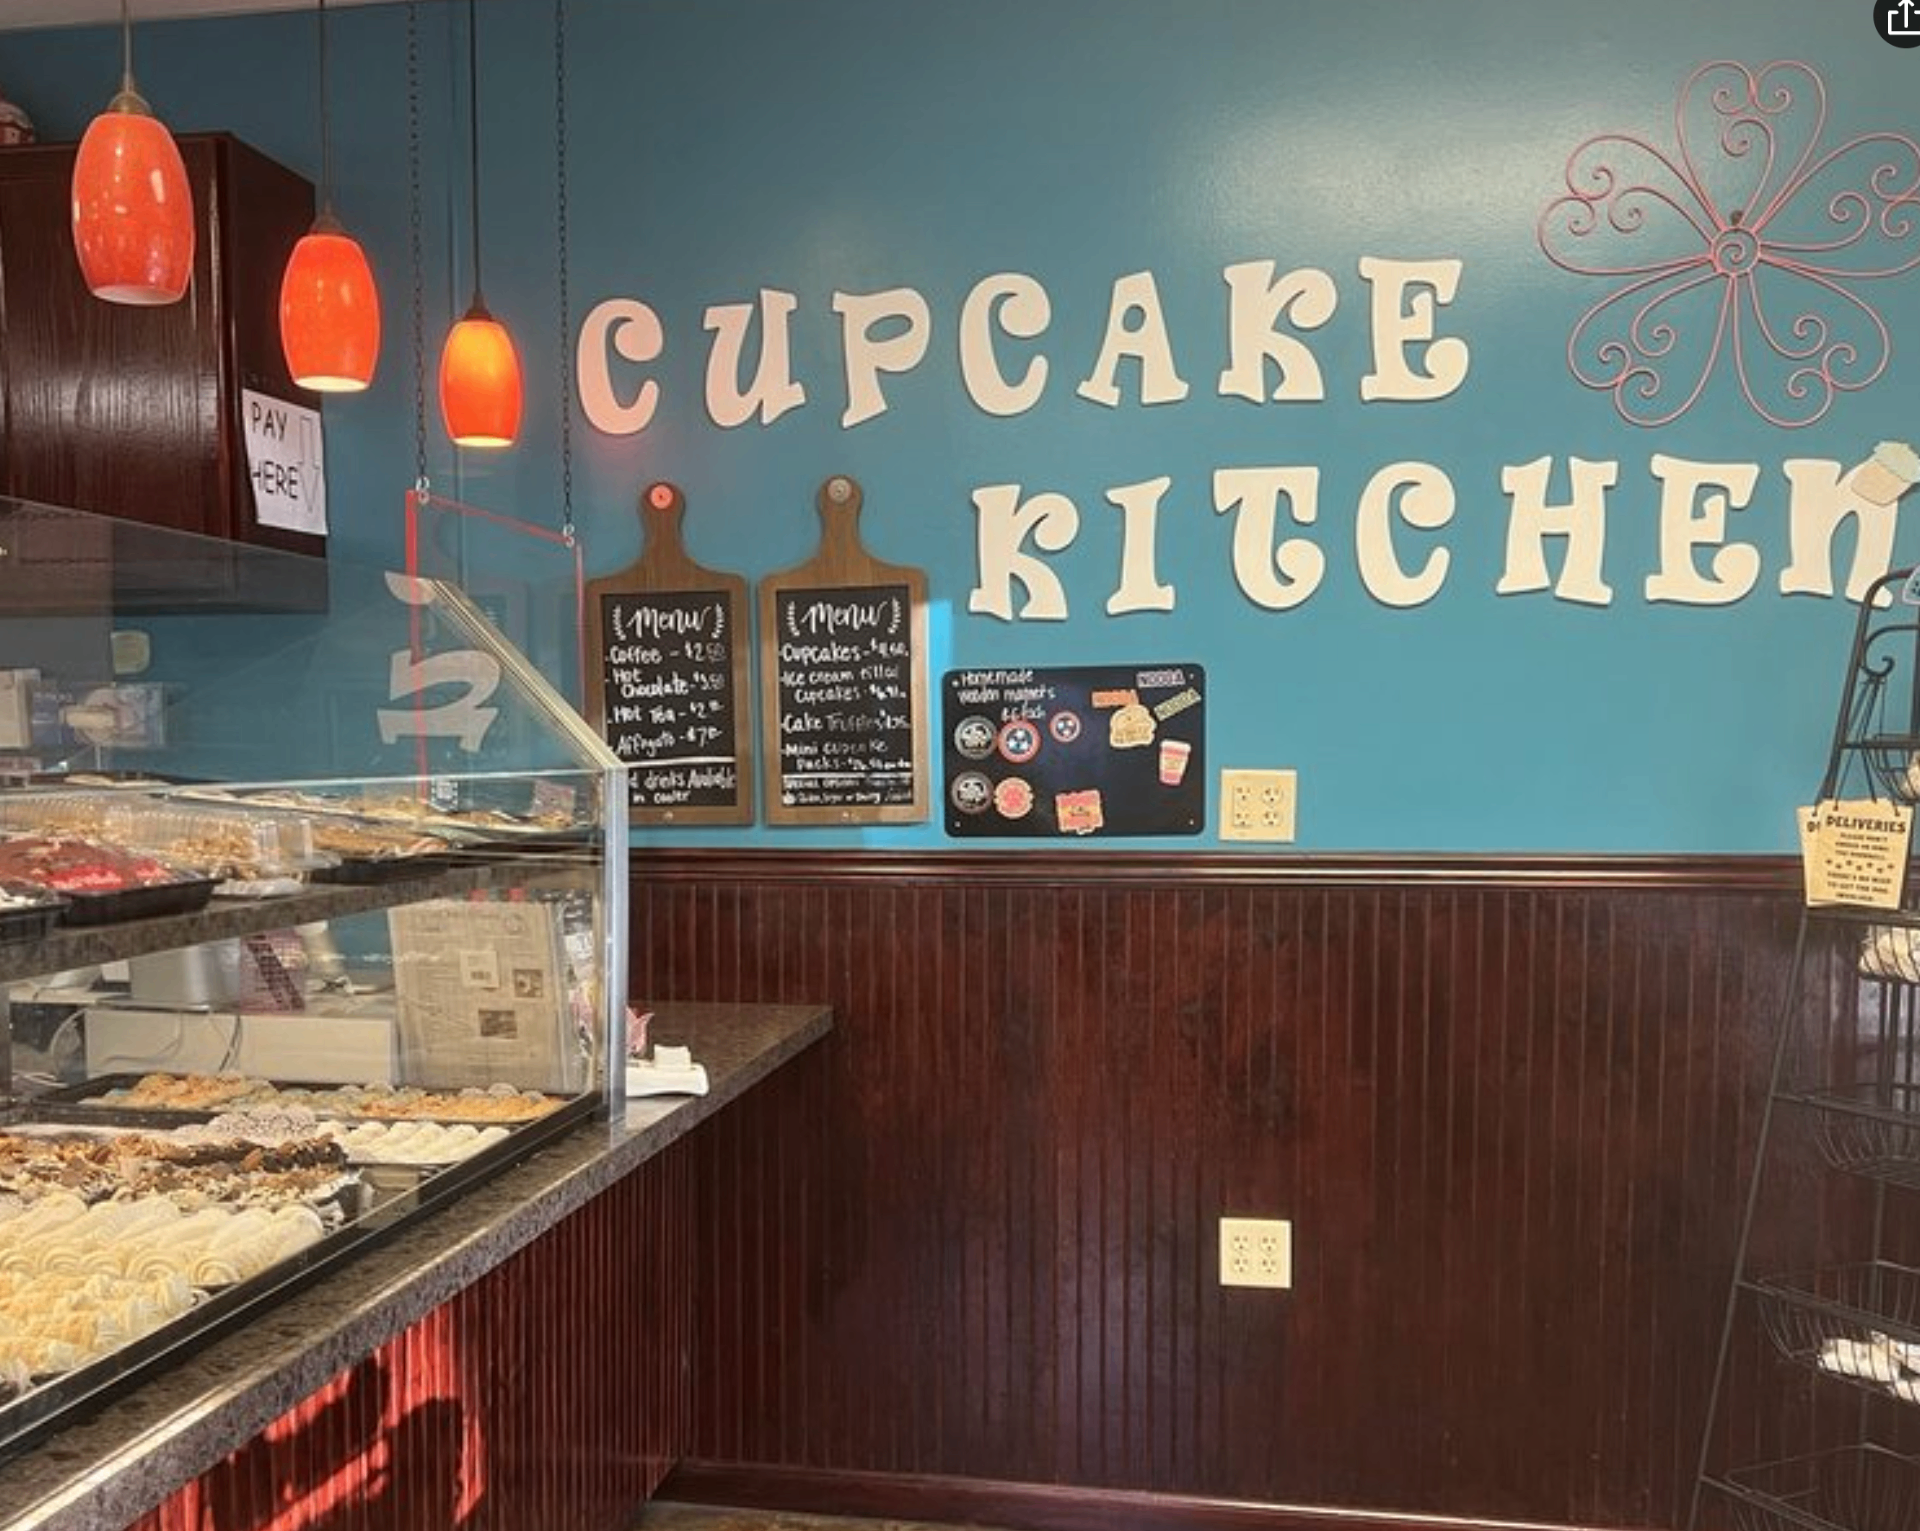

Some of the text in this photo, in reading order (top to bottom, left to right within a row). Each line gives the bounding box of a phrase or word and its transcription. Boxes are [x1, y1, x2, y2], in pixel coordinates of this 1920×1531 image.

[577, 256, 1468, 435] CUPCAKE
[252, 401, 287, 441] PAY
[968, 455, 1898, 622] KITCHEN
[626, 606, 712, 639] Menu
[801, 601, 888, 634] Menu
[610, 645, 664, 664] Coffee
[612, 668, 643, 685] Hot
[613, 704, 643, 724] Hot
[1825, 815, 1906, 834] DELIVERIES
